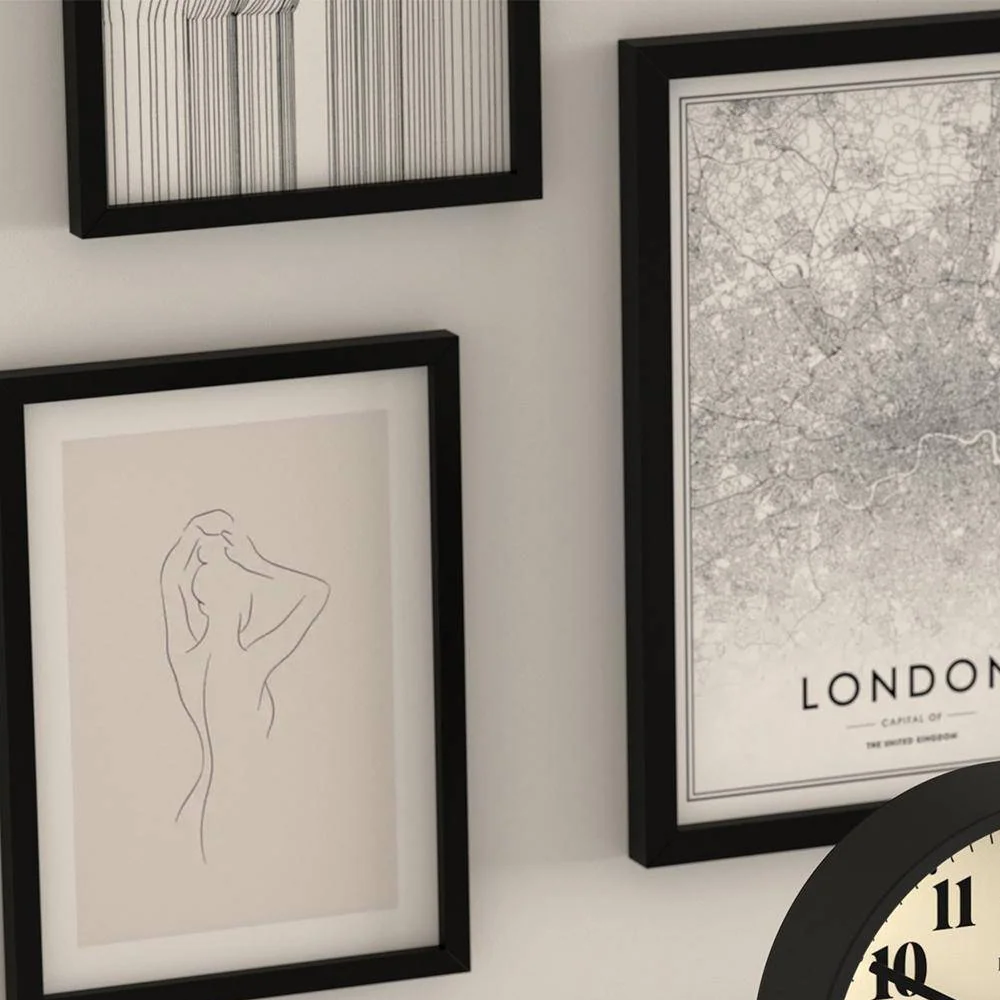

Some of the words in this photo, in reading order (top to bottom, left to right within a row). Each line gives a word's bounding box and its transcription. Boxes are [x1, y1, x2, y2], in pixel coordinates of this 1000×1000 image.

[881, 714, 924, 727] CAPITAL
[928, 712, 943, 723] OF
[932, 875, 976, 931] 11
